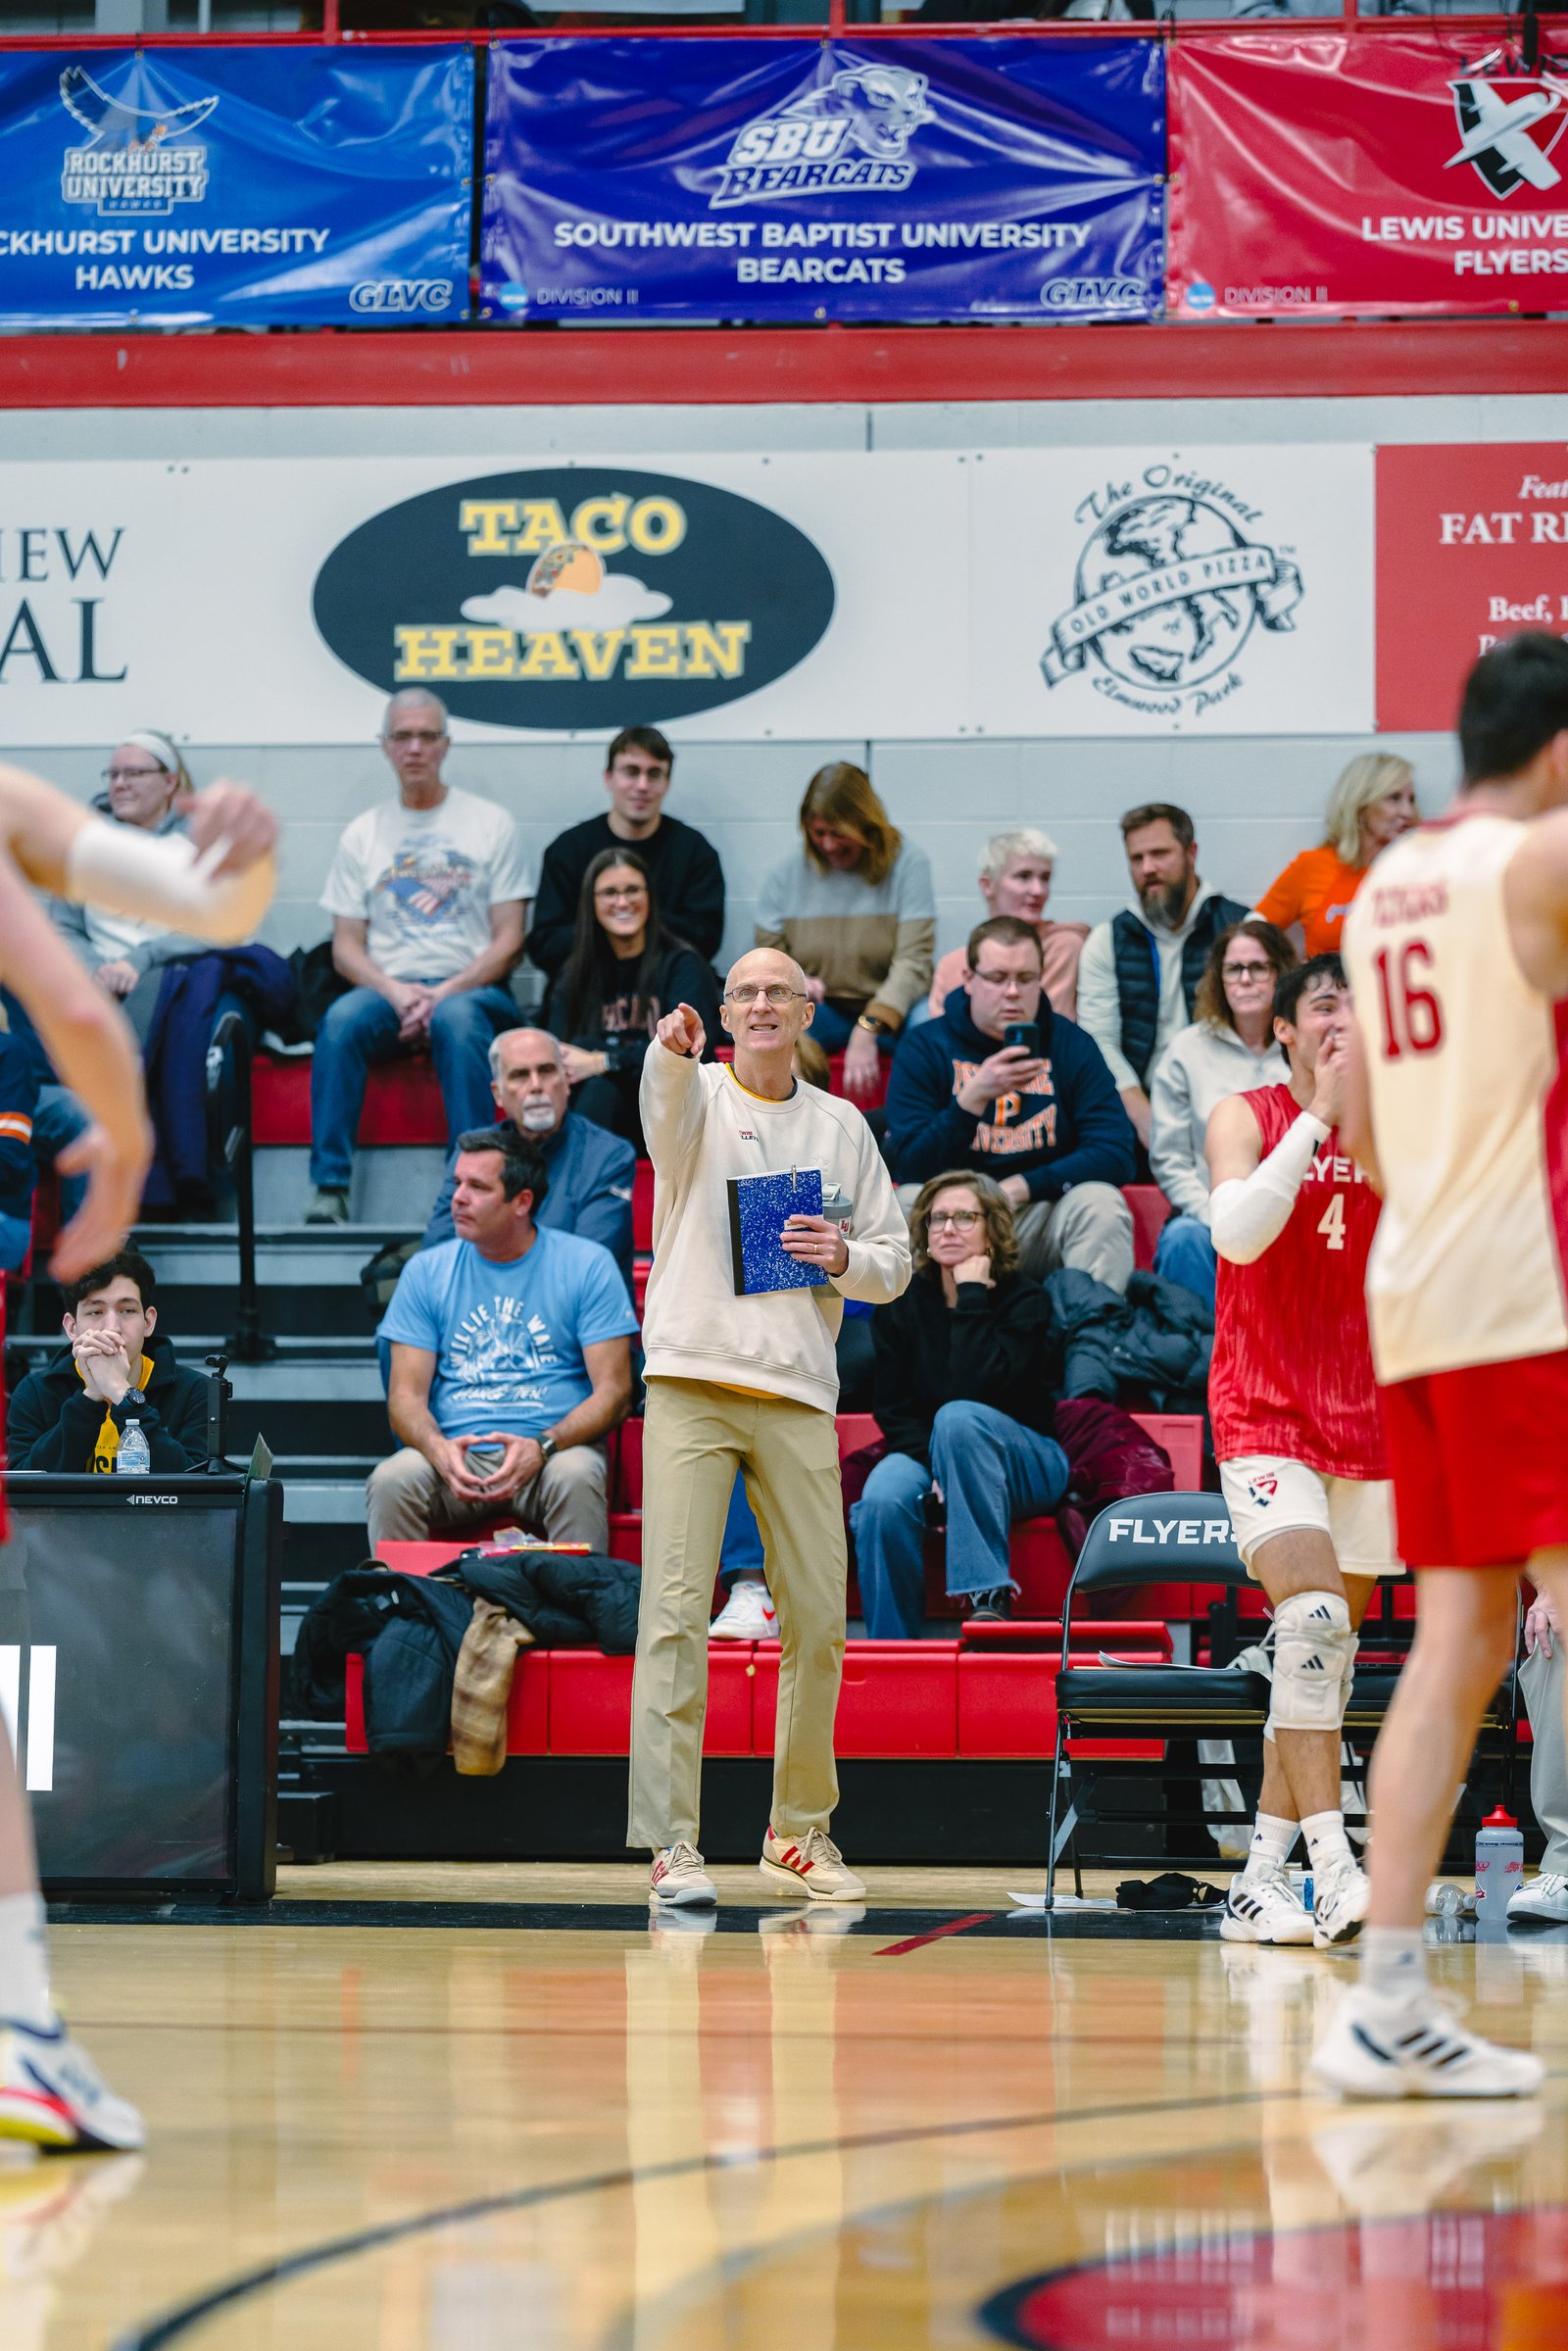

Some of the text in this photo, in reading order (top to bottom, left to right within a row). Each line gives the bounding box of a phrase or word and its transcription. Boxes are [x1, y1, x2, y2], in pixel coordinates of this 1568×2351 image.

[735, 119, 852, 165] SBU
[70, 151, 200, 174] ROCKHURST
[66, 174, 204, 198] UNIVERSITY
[710, 159, 914, 204] BEARCATS
[143, 227, 331, 254] UNIVERSITY
[553, 221, 1093, 249] SOUTHWEST BAPTIST UNIVERSITY
[1361, 214, 1568, 241] LEWIS UNIVE
[74, 264, 196, 290] HAWKS
[736, 257, 907, 284] BEARCATS
[1453, 247, 1568, 275] FLYERS
[349, 279, 453, 313] GLVC
[536, 286, 622, 306] DIVISION
[1224, 285, 1311, 306] DIVISION
[1074, 464, 1264, 525] The Original
[459, 492, 688, 557] TACO
[1439, 512, 1523, 545] FAT
[1070, 554, 1267, 635] OLD WORLD PIZZA
[1488, 593, 1553, 624] Beef,
[394, 619, 753, 682] HEAVEN
[1091, 671, 1245, 716] Elmwood Park
[1373, 938, 1446, 1063] 16
[994, 1091, 1021, 1128] P
[1316, 1193, 1347, 1250] 4
[449, 1303, 491, 1368] WILLIE
[493, 1296, 524, 1319] THE
[135, 1495, 178, 1504] NEVCO
